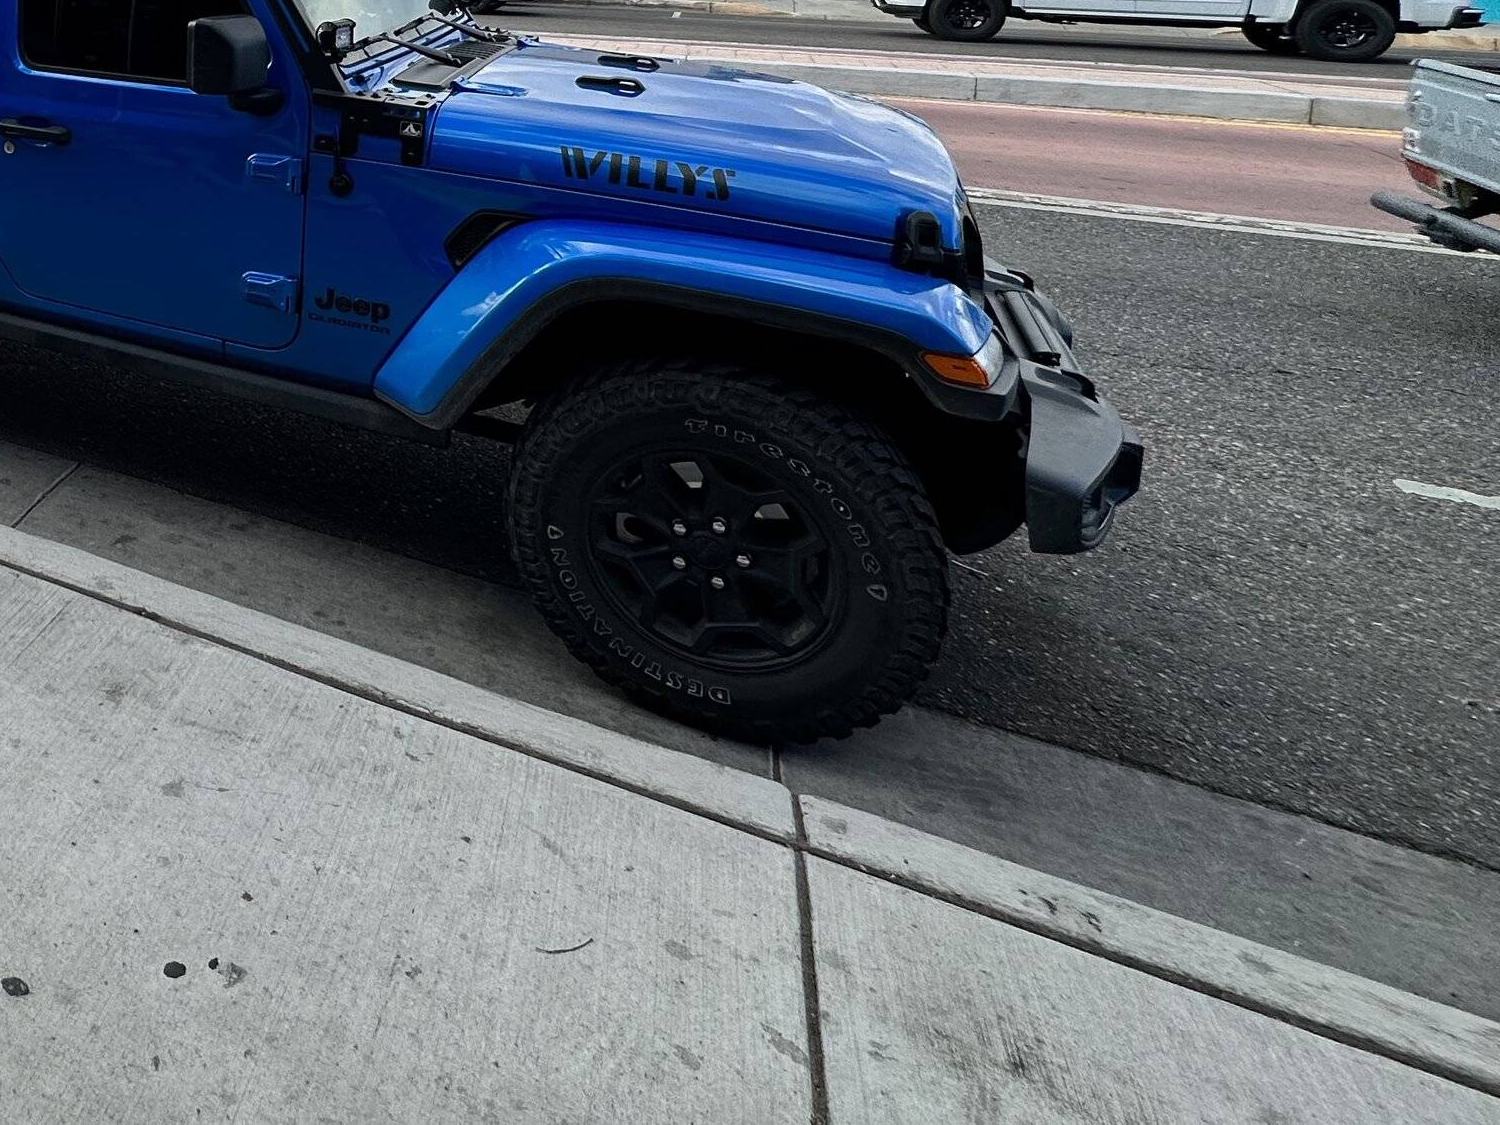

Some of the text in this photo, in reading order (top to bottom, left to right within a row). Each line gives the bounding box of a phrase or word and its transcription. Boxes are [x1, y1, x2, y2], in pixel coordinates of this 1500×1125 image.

[559, 145, 737, 202] WILLYS
[314, 287, 390, 323] Jeep
[550, 547, 731, 705] DESTINATION
